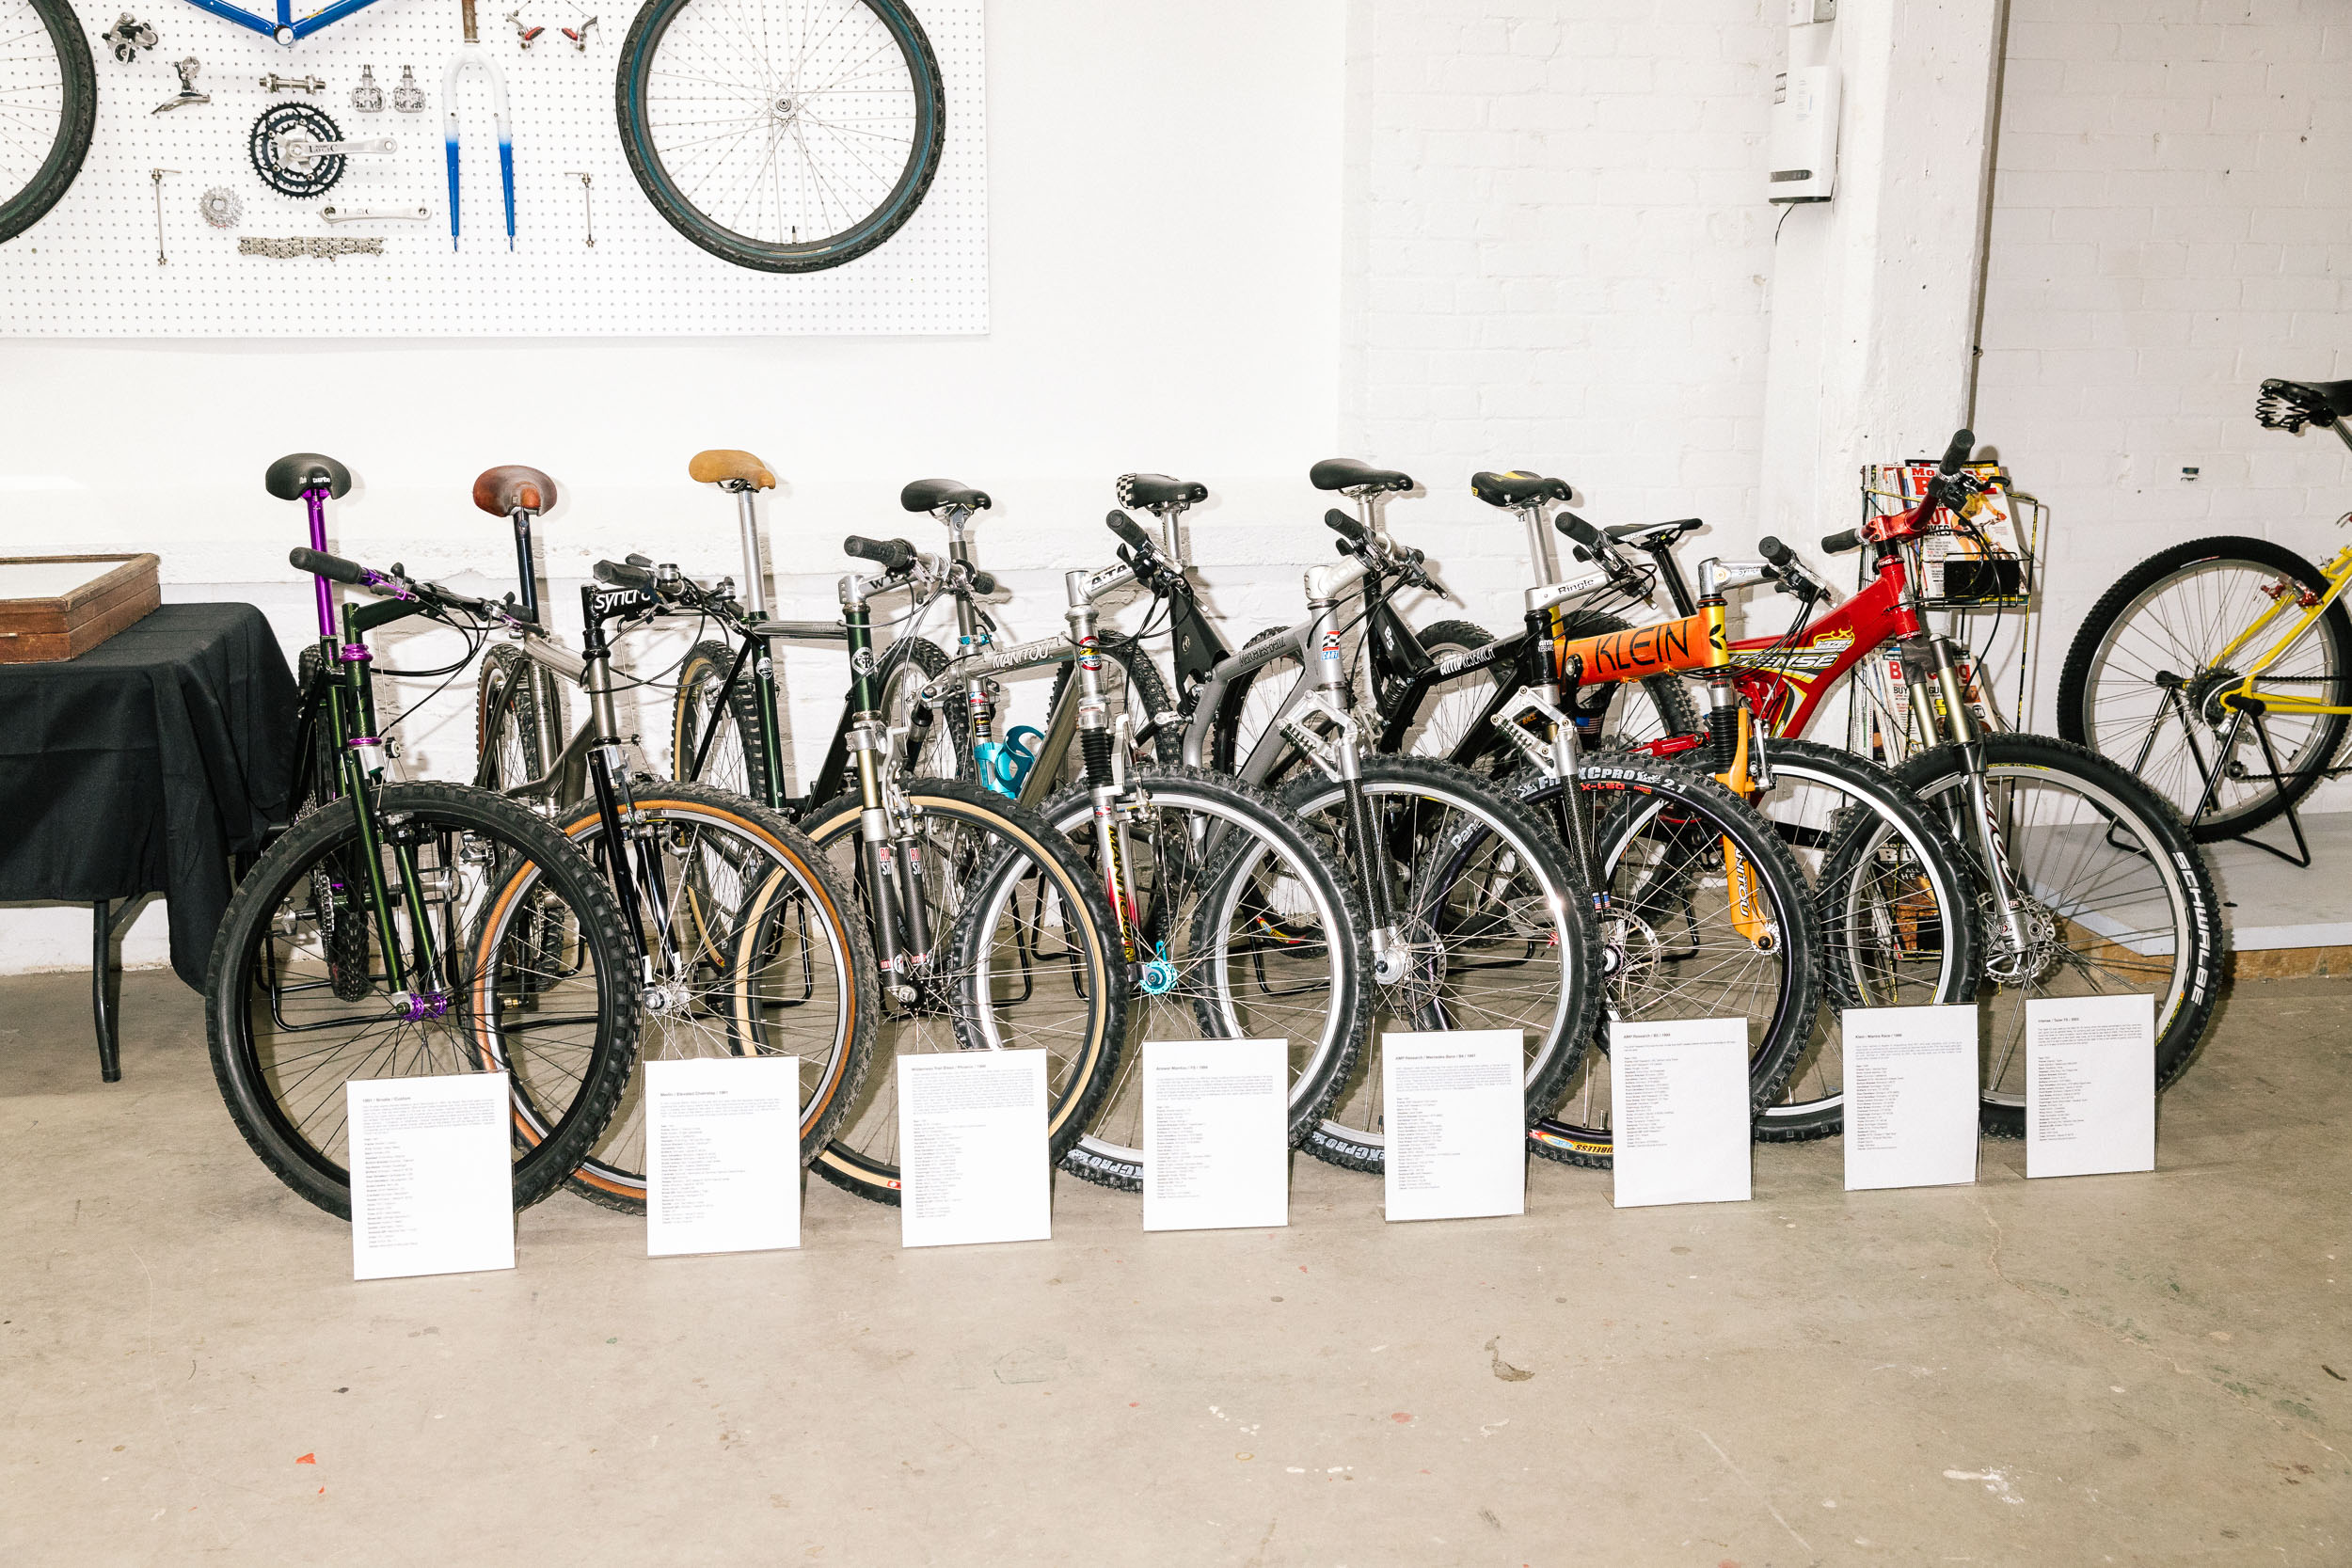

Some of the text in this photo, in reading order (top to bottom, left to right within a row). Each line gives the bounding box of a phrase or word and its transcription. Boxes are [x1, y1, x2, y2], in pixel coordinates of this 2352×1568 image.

[1383, 626, 1395, 651] B5
[1595, 620, 1690, 673] KLEIN
[992, 641, 1053, 669] MANITOU
[1462, 645, 1496, 669] RESEARCH
[1661, 780, 1687, 795] 2.1
[1107, 824, 1134, 942] MANITOU
[2172, 851, 2211, 1006] SCHWALBE
[1575, 1144, 1613, 1153] UBELESS
